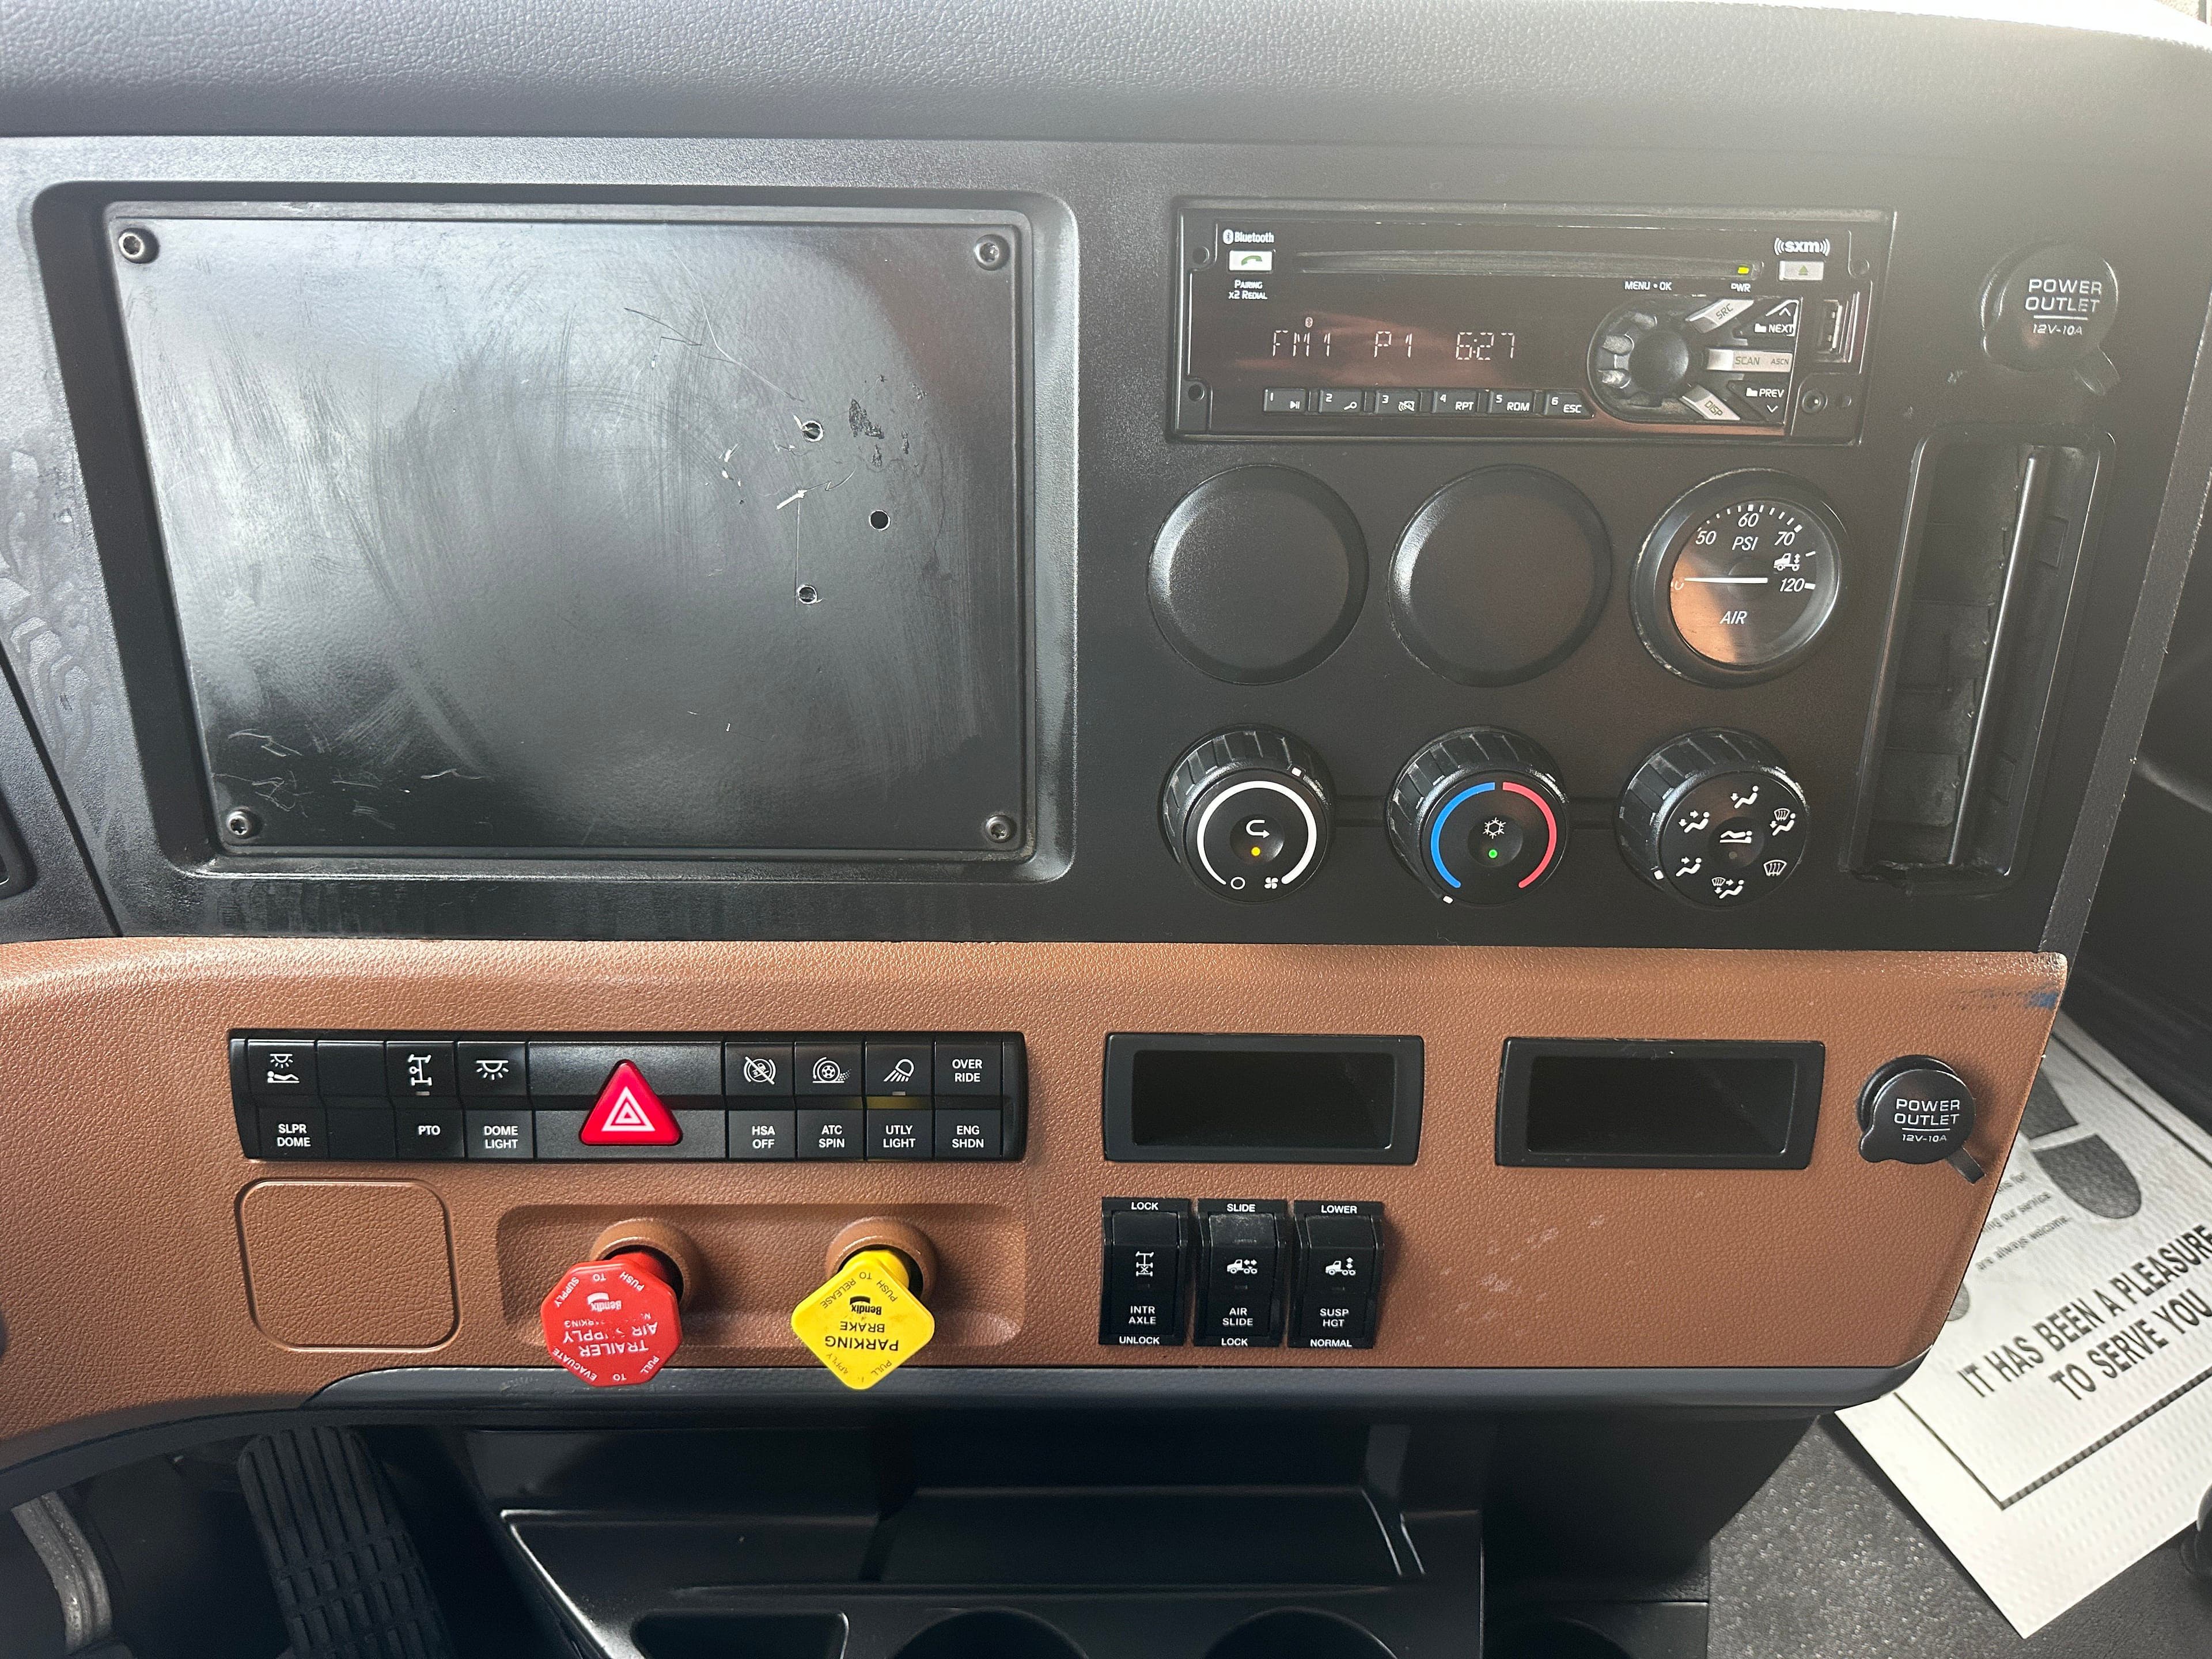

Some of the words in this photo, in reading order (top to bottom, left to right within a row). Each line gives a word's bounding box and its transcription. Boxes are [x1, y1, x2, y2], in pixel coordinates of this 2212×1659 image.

[1234, 232, 1274, 244] Bluetooth
[1624, 281, 1650, 290] MENU
[1659, 281, 1672, 291] OK
[1731, 283, 1751, 292] PWR
[2028, 279, 2102, 295] POWER
[2025, 297, 2100, 312] OUTLET
[1715, 303, 1733, 320] SRC
[1768, 324, 1794, 333] NEXT
[2033, 324, 2082, 335] 12V-10A
[1374, 331, 1412, 357] P1
[1734, 356, 1760, 365] SCAN
[1270, 393, 1274, 402] 1
[1325, 394, 1332, 403] 2
[1759, 389, 1785, 397] PREV
[1382, 395, 1389, 404] 3
[1440, 395, 1446, 403] 4
[1455, 402, 1474, 411] RPT
[1495, 395, 1503, 403] 5
[1506, 402, 1530, 411] RDM
[1551, 397, 1559, 406] 6
[1563, 404, 1582, 414] ESC
[1704, 400, 1723, 416] DISP
[1738, 513, 1759, 528] 60
[1695, 531, 1716, 545] 50
[1732, 536, 1759, 551] PSI
[1774, 531, 1796, 546] 70
[1779, 578, 1805, 592] 120
[1719, 611, 1748, 624] AIR
[952, 1059, 983, 1070] OVER
[955, 1072, 980, 1082] RIDE
[1896, 1099, 1960, 1112] POWER
[1894, 1113, 1960, 1126] OUTLET
[278, 1123, 307, 1134] SLPR
[418, 1125, 441, 1136] PTO
[484, 1125, 518, 1136] DOME
[752, 1125, 775, 1135] HSA
[821, 1125, 843, 1135] ATC
[885, 1125, 913, 1135] UTLY
[956, 1125, 980, 1135] ENG
[277, 1137, 311, 1147] DOME
[485, 1138, 518, 1149] LIGHT
[752, 1138, 775, 1149] OFF
[819, 1138, 845, 1148] SPIN
[883, 1138, 916, 1149] LIGHT
[952, 1138, 984, 1149] SHDN
[1902, 1134, 1947, 1142] 12V-10A
[1131, 1202, 1158, 1211] LOCK
[1227, 1203, 1256, 1213] SLIDE
[1321, 1205, 1358, 1214] LOWER
[2108, 1225, 2212, 1305] PLEASURE
[592, 1273, 607, 1282] TO
[620, 1271, 645, 1292] PUSH
[859, 1272, 872, 1280] TO
[554, 1277, 579, 1308] SUPPLY
[820, 1278, 857, 1309] RELEASE
[876, 1280, 898, 1302] PUSH
[591, 1300, 622, 1312] Bendix
[2093, 1289, 2126, 1317] A
[851, 1304, 882, 1315] Bendix
[1130, 1305, 1155, 1314] INTR
[1229, 1308, 1247, 1316] AIR
[1320, 1308, 1349, 1317] SUSP
[1128, 1316, 1156, 1325] AXLE
[1222, 1317, 1253, 1326] SLIDE
[1323, 1319, 1344, 1327] HGT
[2032, 1297, 2105, 1351] BEEN
[631, 1321, 658, 1337] AIR
[840, 1321, 885, 1333] BRAKE
[562, 1327, 625, 1344] PPLY
[1119, 1336, 1160, 1345] UNLOCK
[578, 1339, 649, 1357] TRAILER
[825, 1335, 899, 1351] PARKING
[1221, 1338, 1248, 1347] LOCK
[1310, 1339, 1353, 1347] NORMAL
[2048, 1363, 2097, 1401] TO
[2087, 1319, 2169, 1379] SERVE
[2152, 1287, 2212, 1335] YOU
[552, 1348, 597, 1381] EVACUATE
[641, 1355, 660, 1374] PULL
[1983, 1336, 2044, 1382] HAS
[871, 1360, 892, 1376] PULL
[1957, 1363, 1995, 1398] IT
